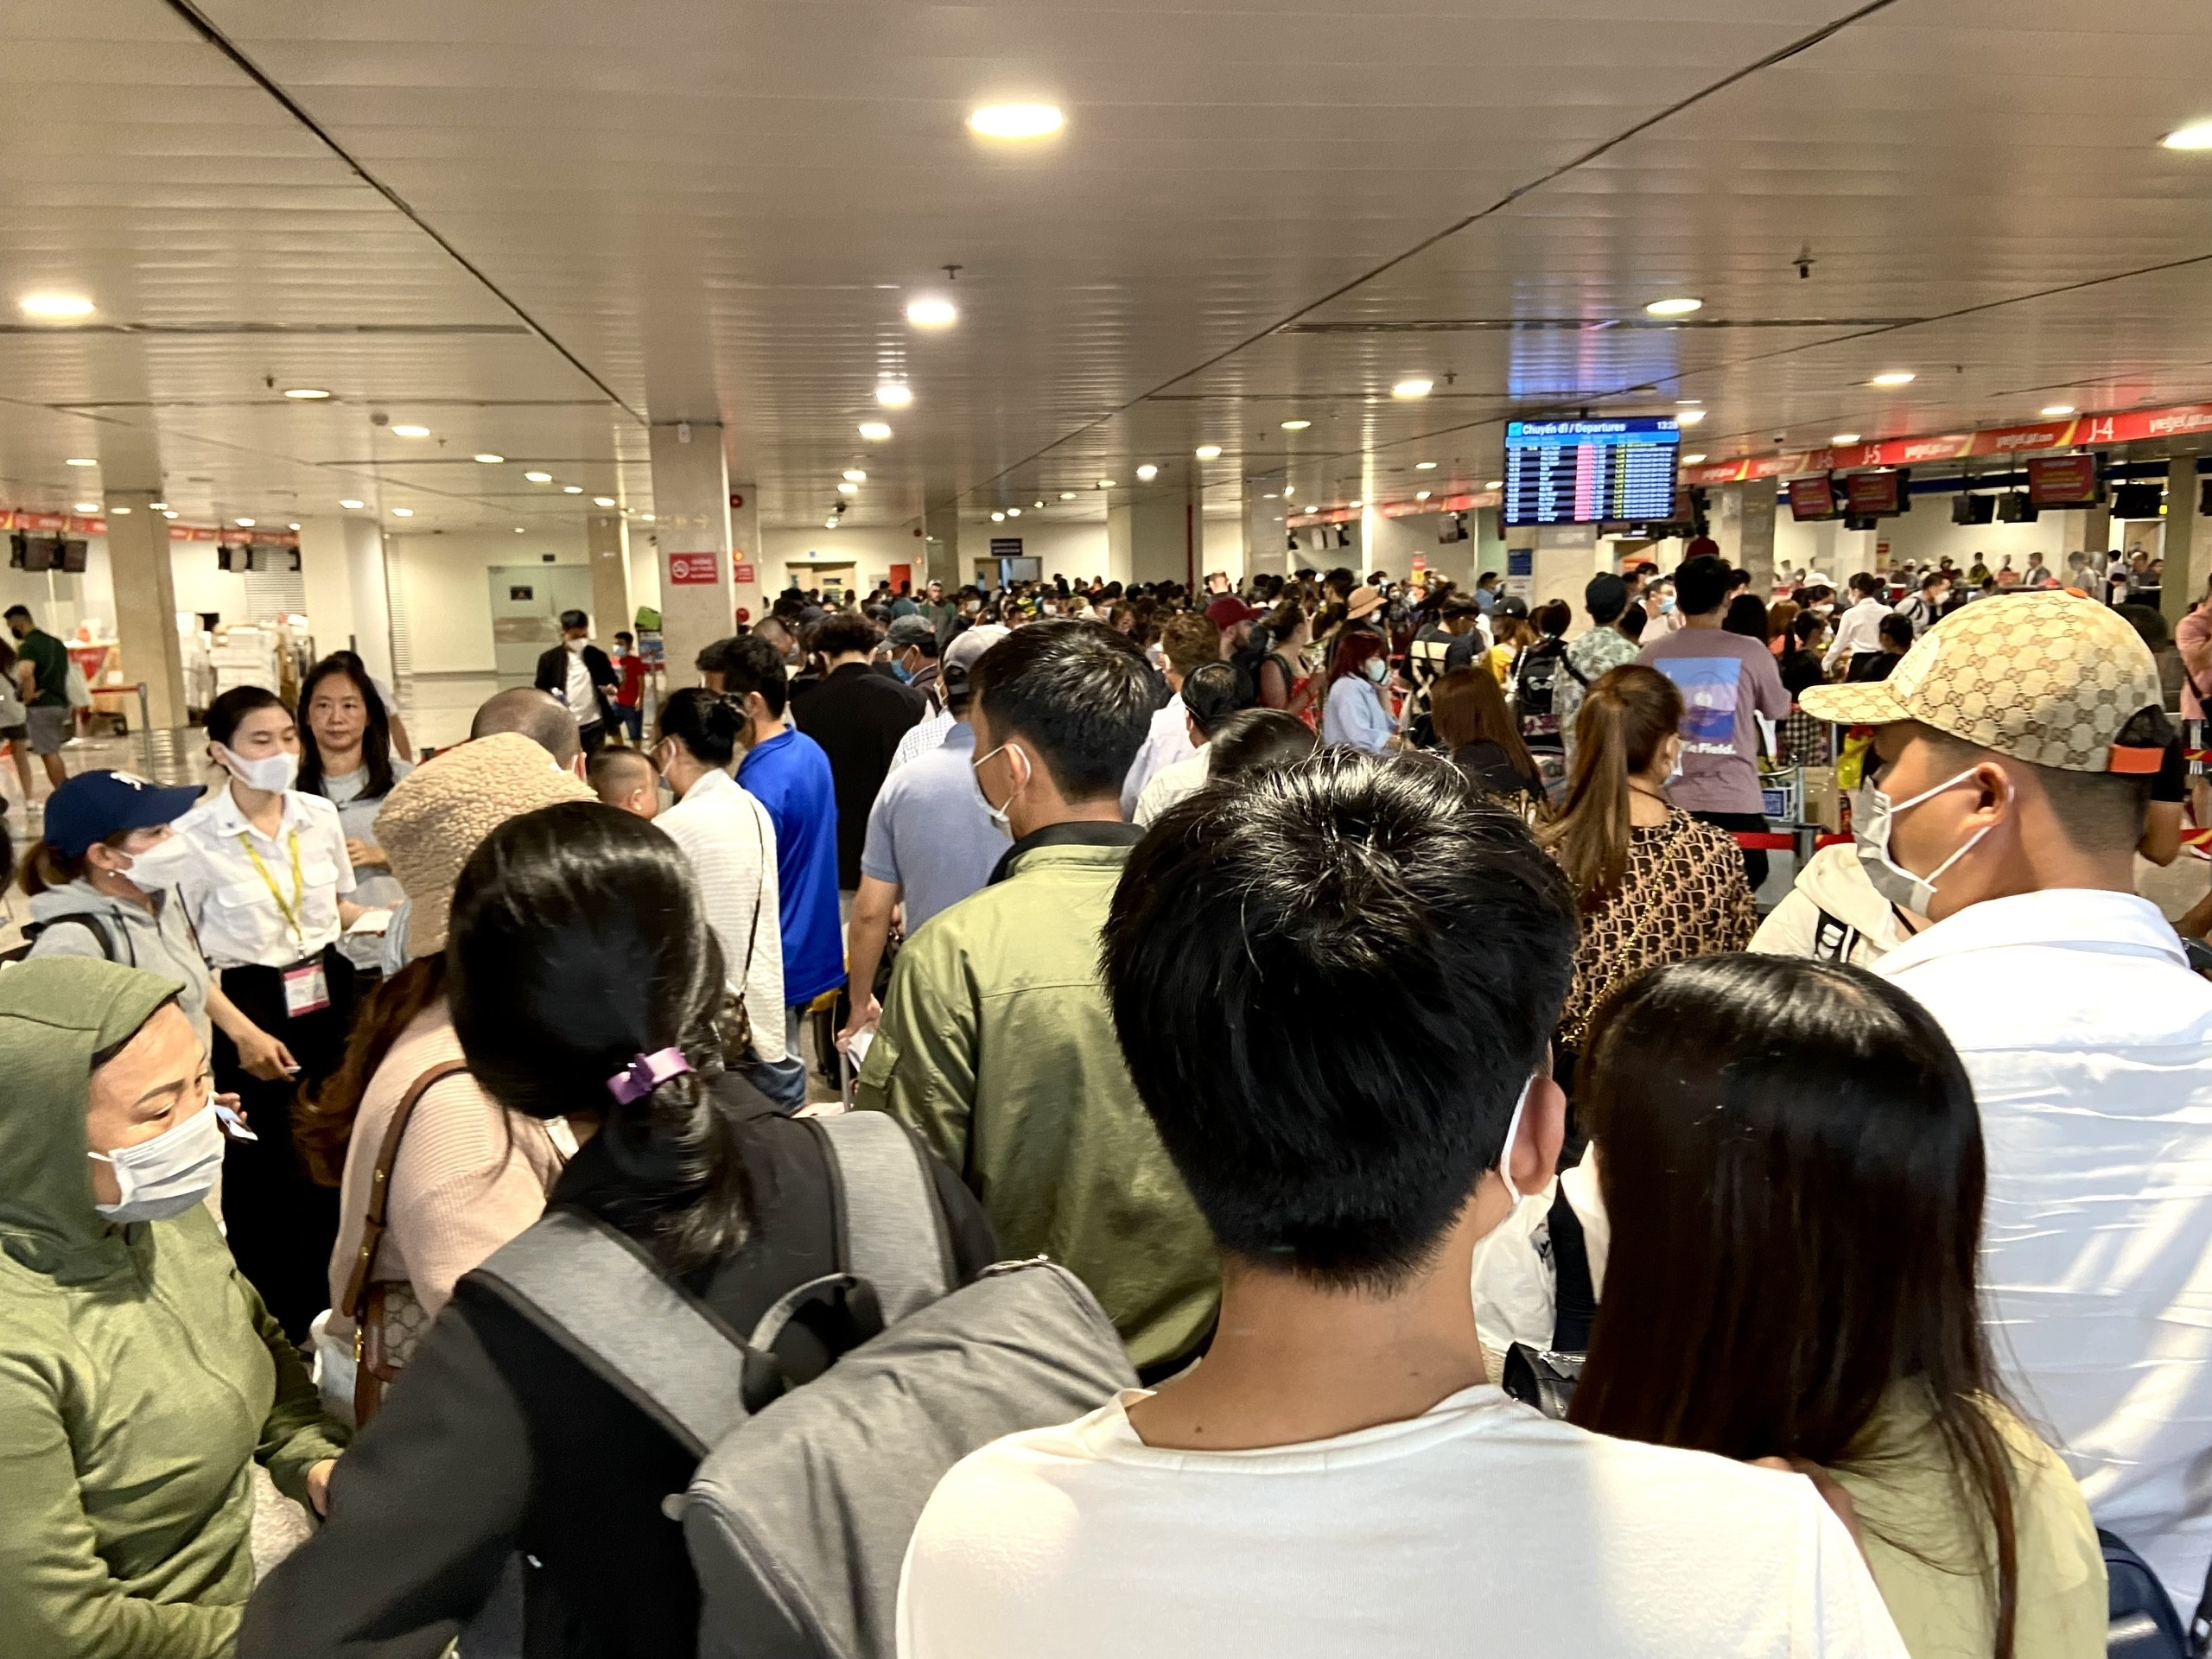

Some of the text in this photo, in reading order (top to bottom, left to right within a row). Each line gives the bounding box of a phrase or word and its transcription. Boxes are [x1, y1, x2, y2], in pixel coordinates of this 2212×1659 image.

[1574, 423, 1626, 435] Departures
[2088, 417, 2114, 442] J-4
[1862, 444, 1881, 465] J-5
